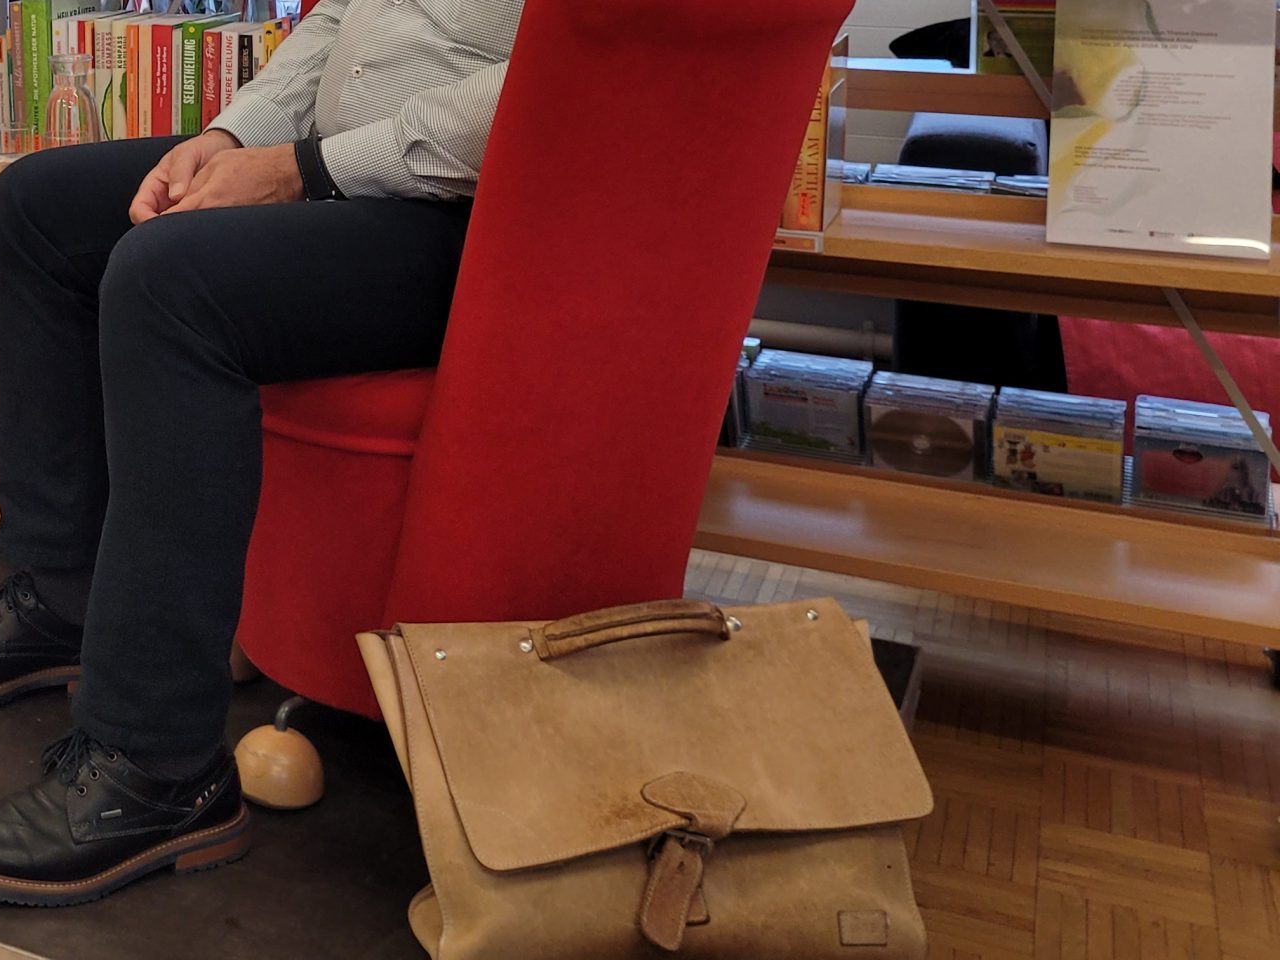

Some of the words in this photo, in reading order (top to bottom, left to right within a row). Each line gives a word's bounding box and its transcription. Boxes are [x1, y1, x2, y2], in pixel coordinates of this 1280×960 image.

[183, 39, 196, 105] SELBSTHEILUNG
[225, 76, 233, 107] NNERE
[807, 138, 820, 205] WILLIAM
